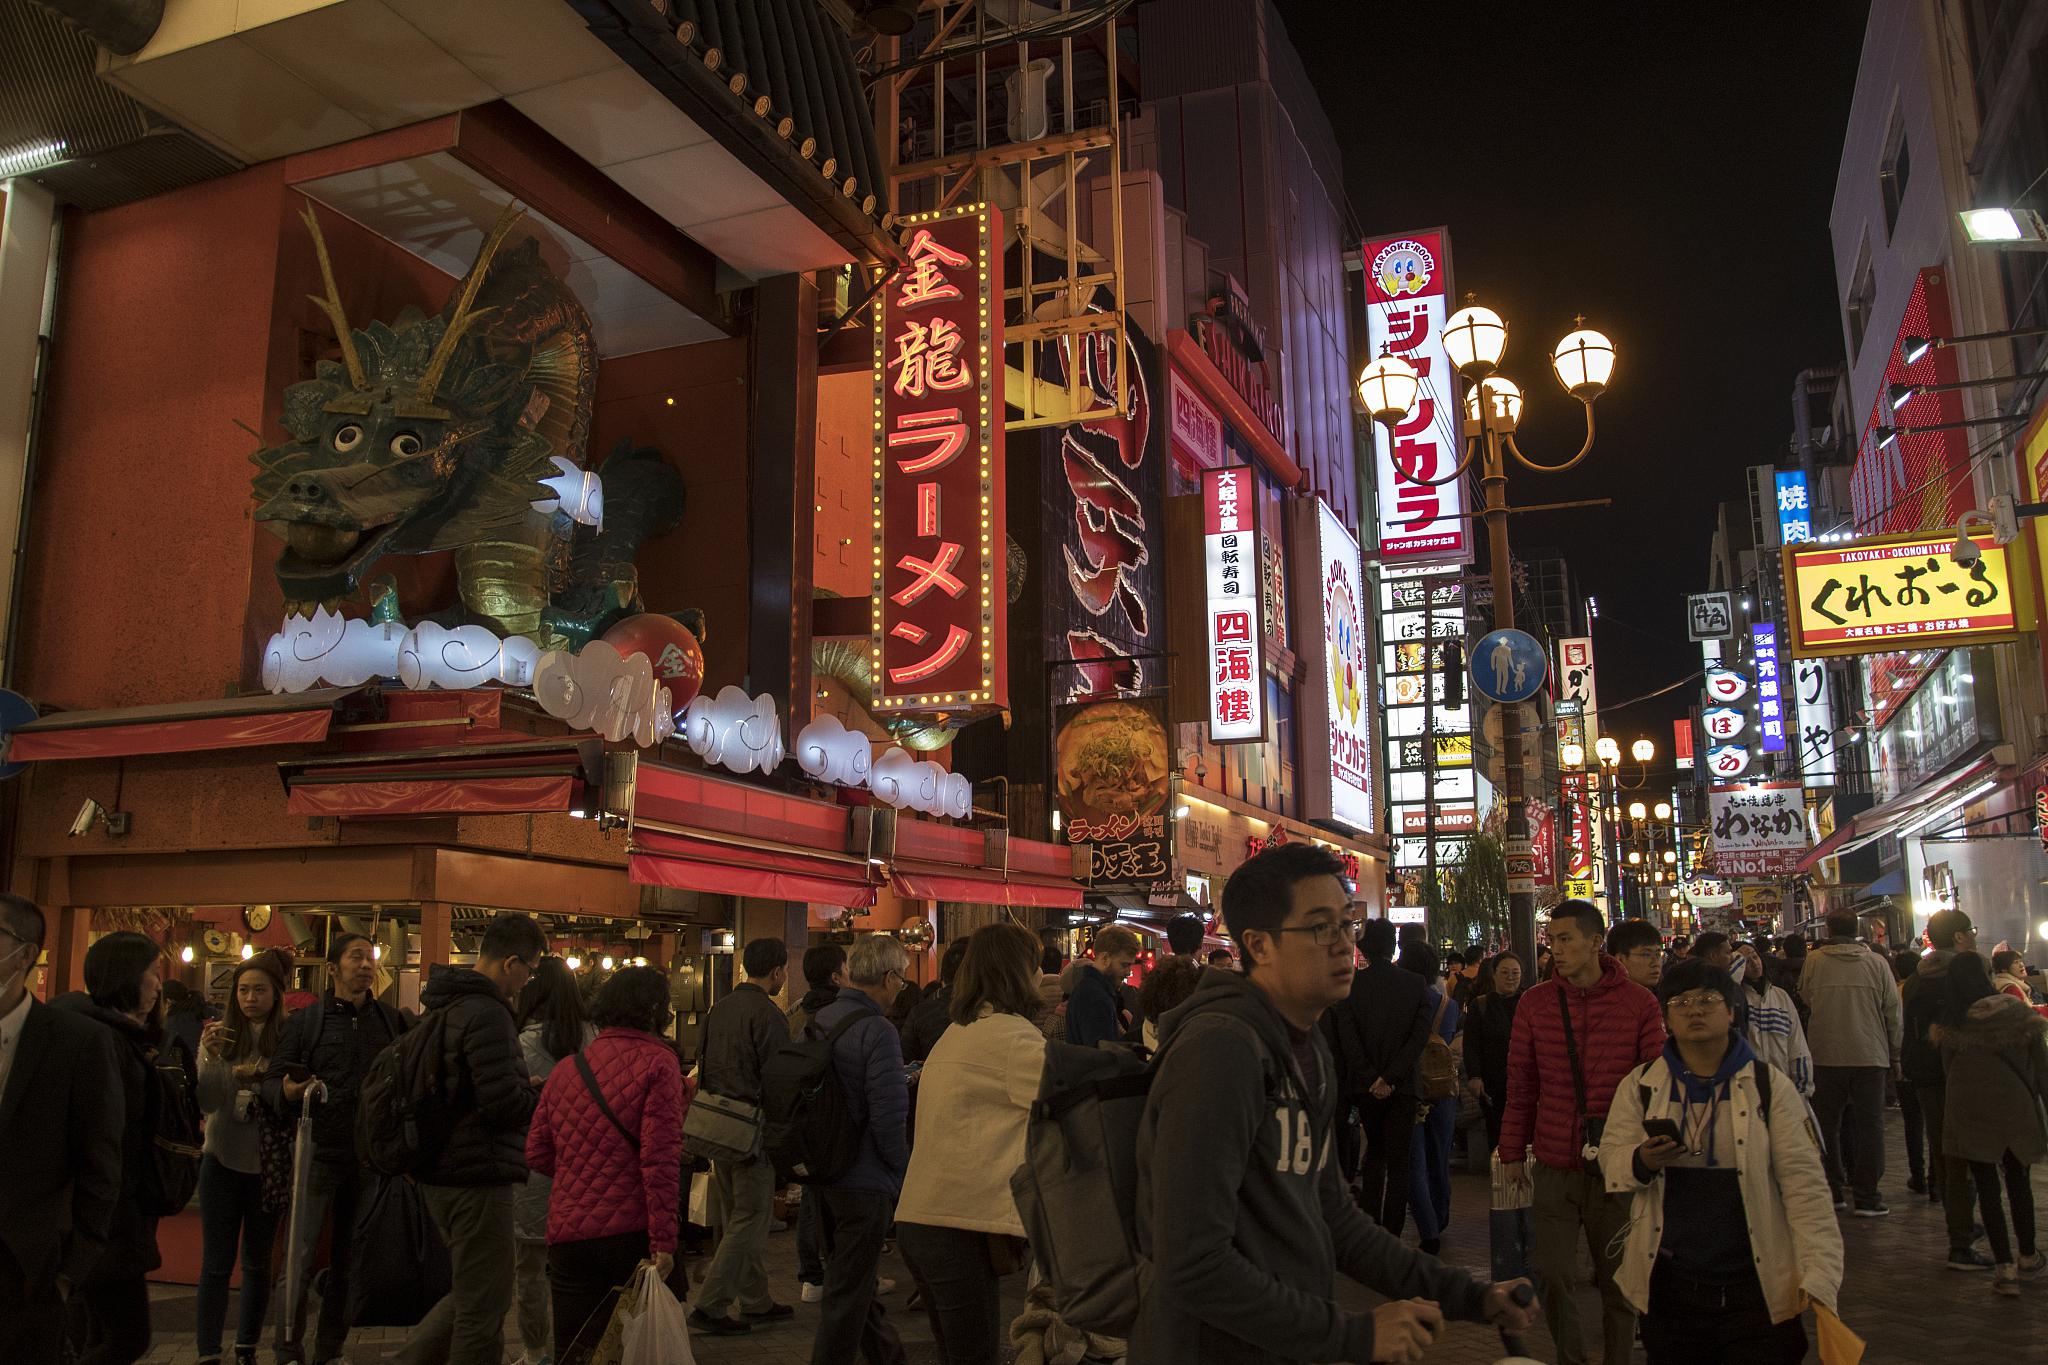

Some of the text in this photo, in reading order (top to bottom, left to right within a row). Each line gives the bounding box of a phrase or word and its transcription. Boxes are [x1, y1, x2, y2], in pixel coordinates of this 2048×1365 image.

[888, 229, 973, 684] 金龍ラーメン
[1218, 471, 1239, 532] 大起水産
[1777, 485, 1811, 544] 焼肉
[1222, 534, 1239, 595] 回転寿司
[1811, 558, 1997, 625] くれおーる
[1695, 605, 1726, 627] 牛角
[1845, 624, 1883, 637] 大阪名物
[655, 643, 692, 678] 金
[1068, 809, 1141, 842] ラーメン
[1714, 806, 1802, 840] わなか
[1733, 859, 1766, 873] No.1
[1573, 883, 1587, 896] 薬
[1275, 1107, 1312, 1175] 18
